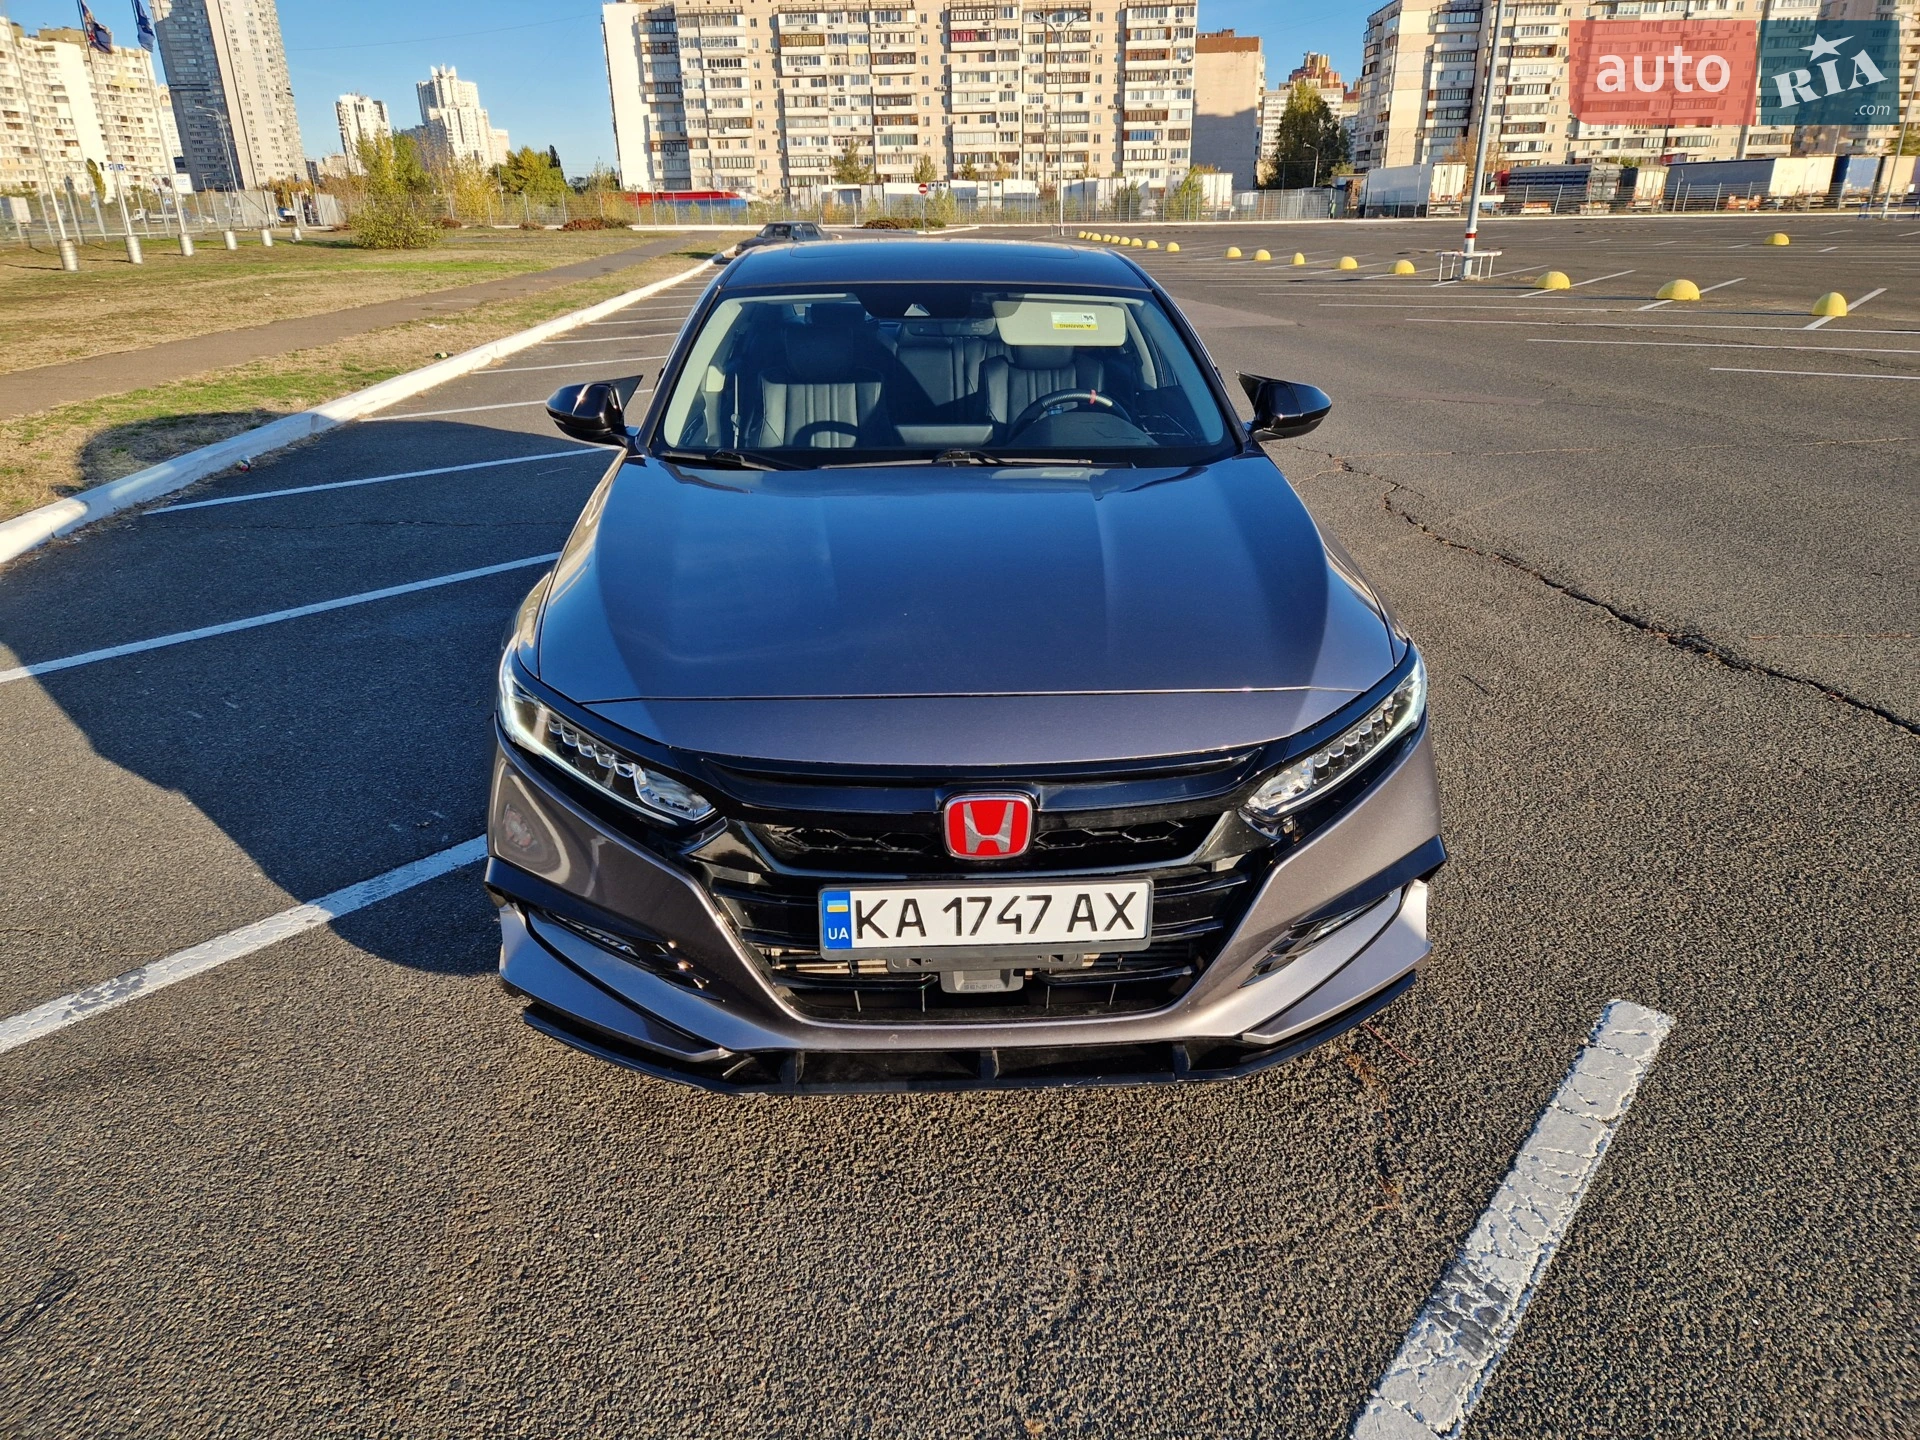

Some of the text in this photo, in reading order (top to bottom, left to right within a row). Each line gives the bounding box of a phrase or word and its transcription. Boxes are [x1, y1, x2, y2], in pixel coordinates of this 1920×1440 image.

[855, 891, 1137, 939] KA 1747 AX
[828, 927, 849, 940] UA
